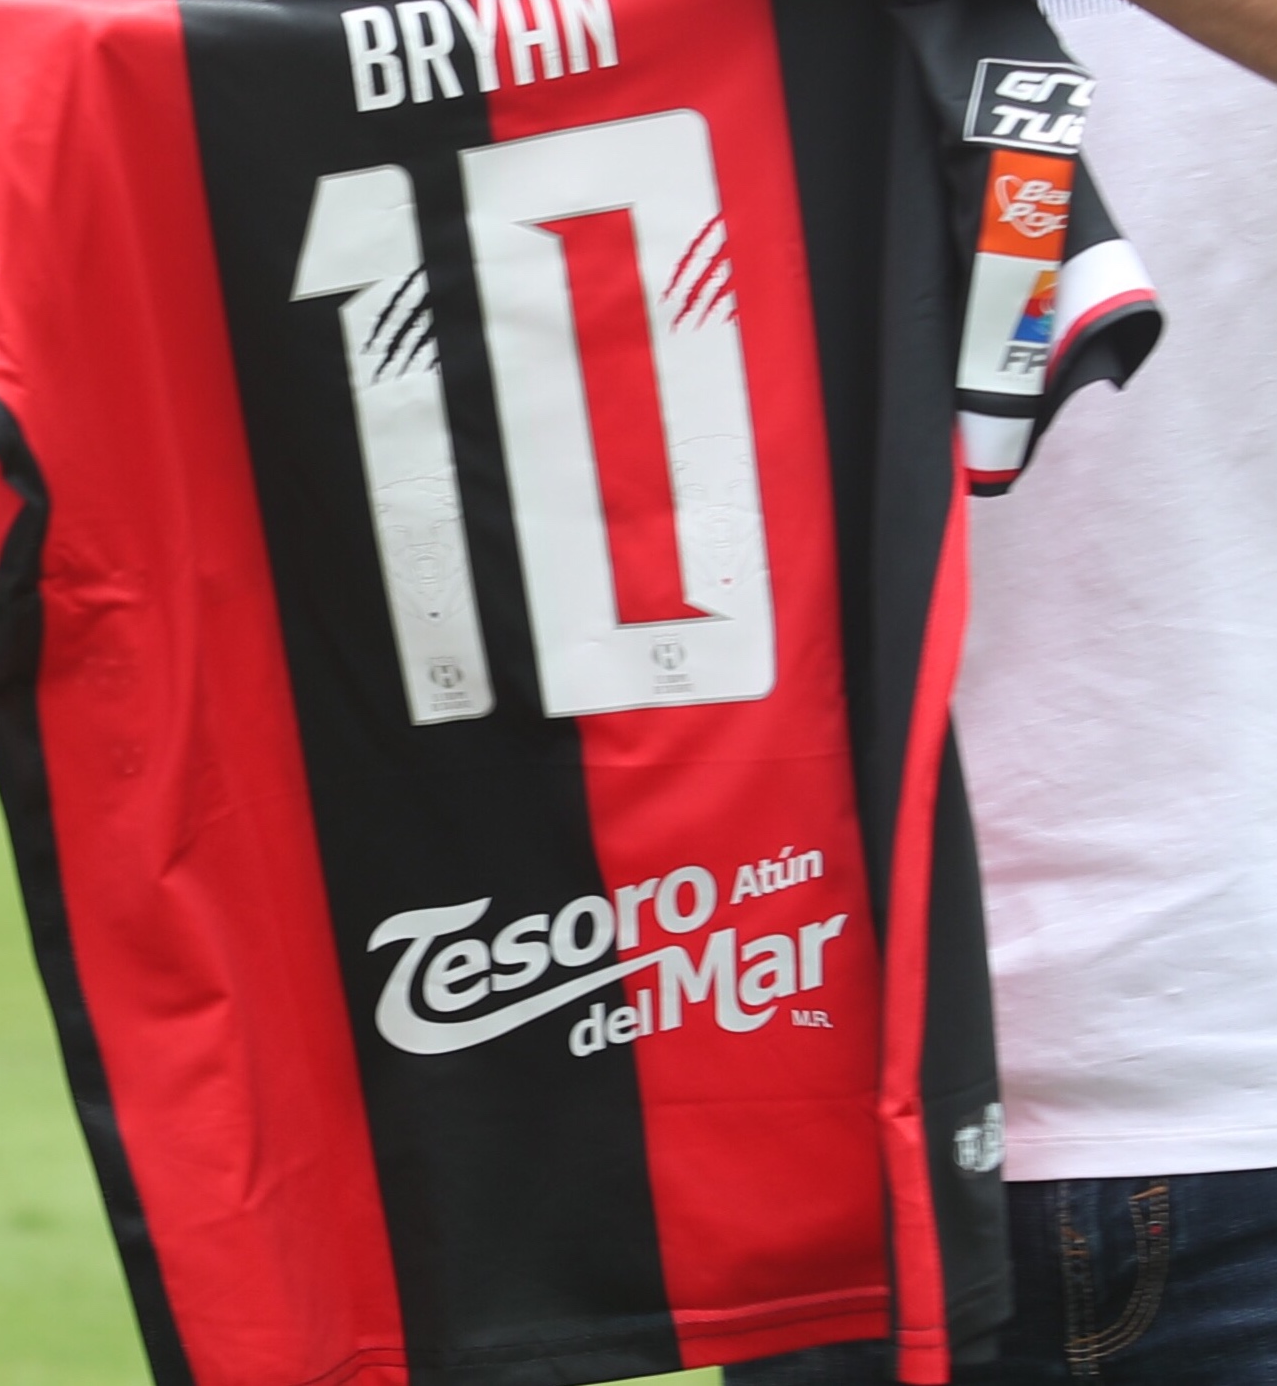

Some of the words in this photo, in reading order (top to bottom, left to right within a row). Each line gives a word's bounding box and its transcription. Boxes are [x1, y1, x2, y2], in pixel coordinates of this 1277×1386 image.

[289, 107, 778, 727] 10
[367, 865, 717, 1054] Tesoro
[730, 846, 823, 905] Atún
[569, 990, 652, 1057] del
[659, 914, 848, 1032] Mar
